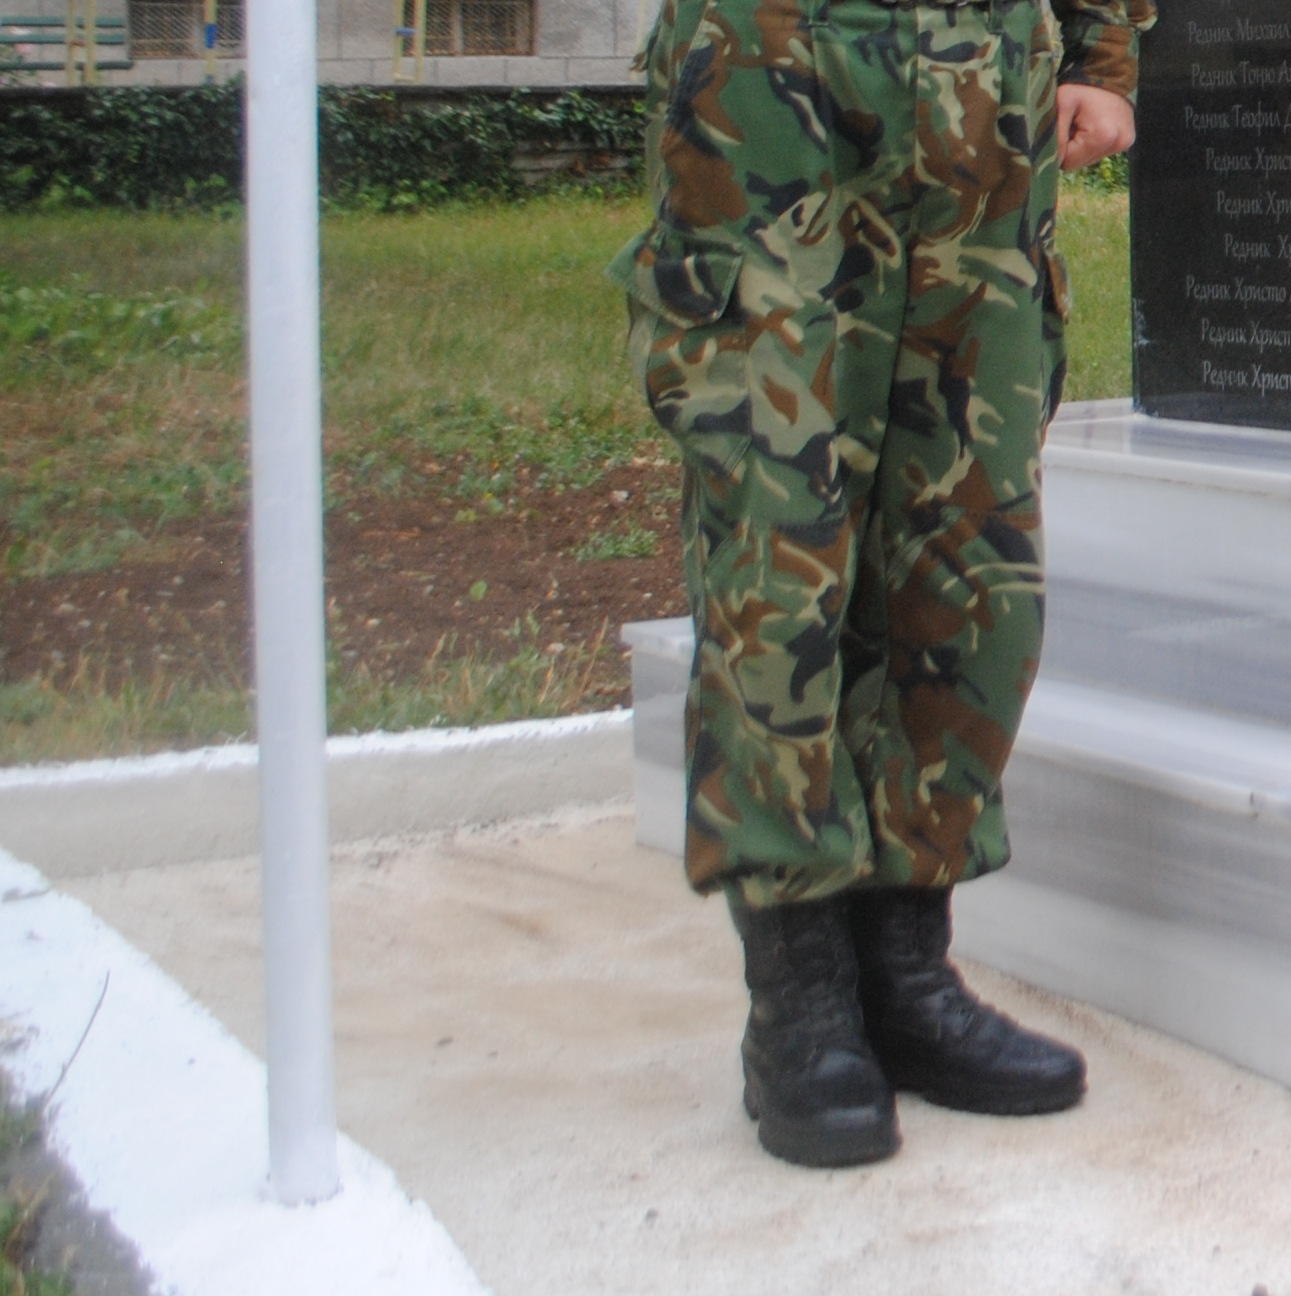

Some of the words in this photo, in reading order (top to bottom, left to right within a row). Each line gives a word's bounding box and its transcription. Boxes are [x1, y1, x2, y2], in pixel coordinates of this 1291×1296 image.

[1187, 19, 1233, 47] Редник
[1236, 16, 1289, 41] Михаил
[1191, 61, 1237, 89] Редник
[1184, 104, 1229, 132] Редник
[1231, 100, 1280, 136] Теофил
[1205, 146, 1251, 175] Редник
[1216, 189, 1263, 218] Редник
[1224, 233, 1270, 262] Редник
[1185, 273, 1231, 302] Редник
[1233, 275, 1286, 309] Христо
[1200, 317, 1246, 346] Редник
[1202, 360, 1248, 390] Редник
